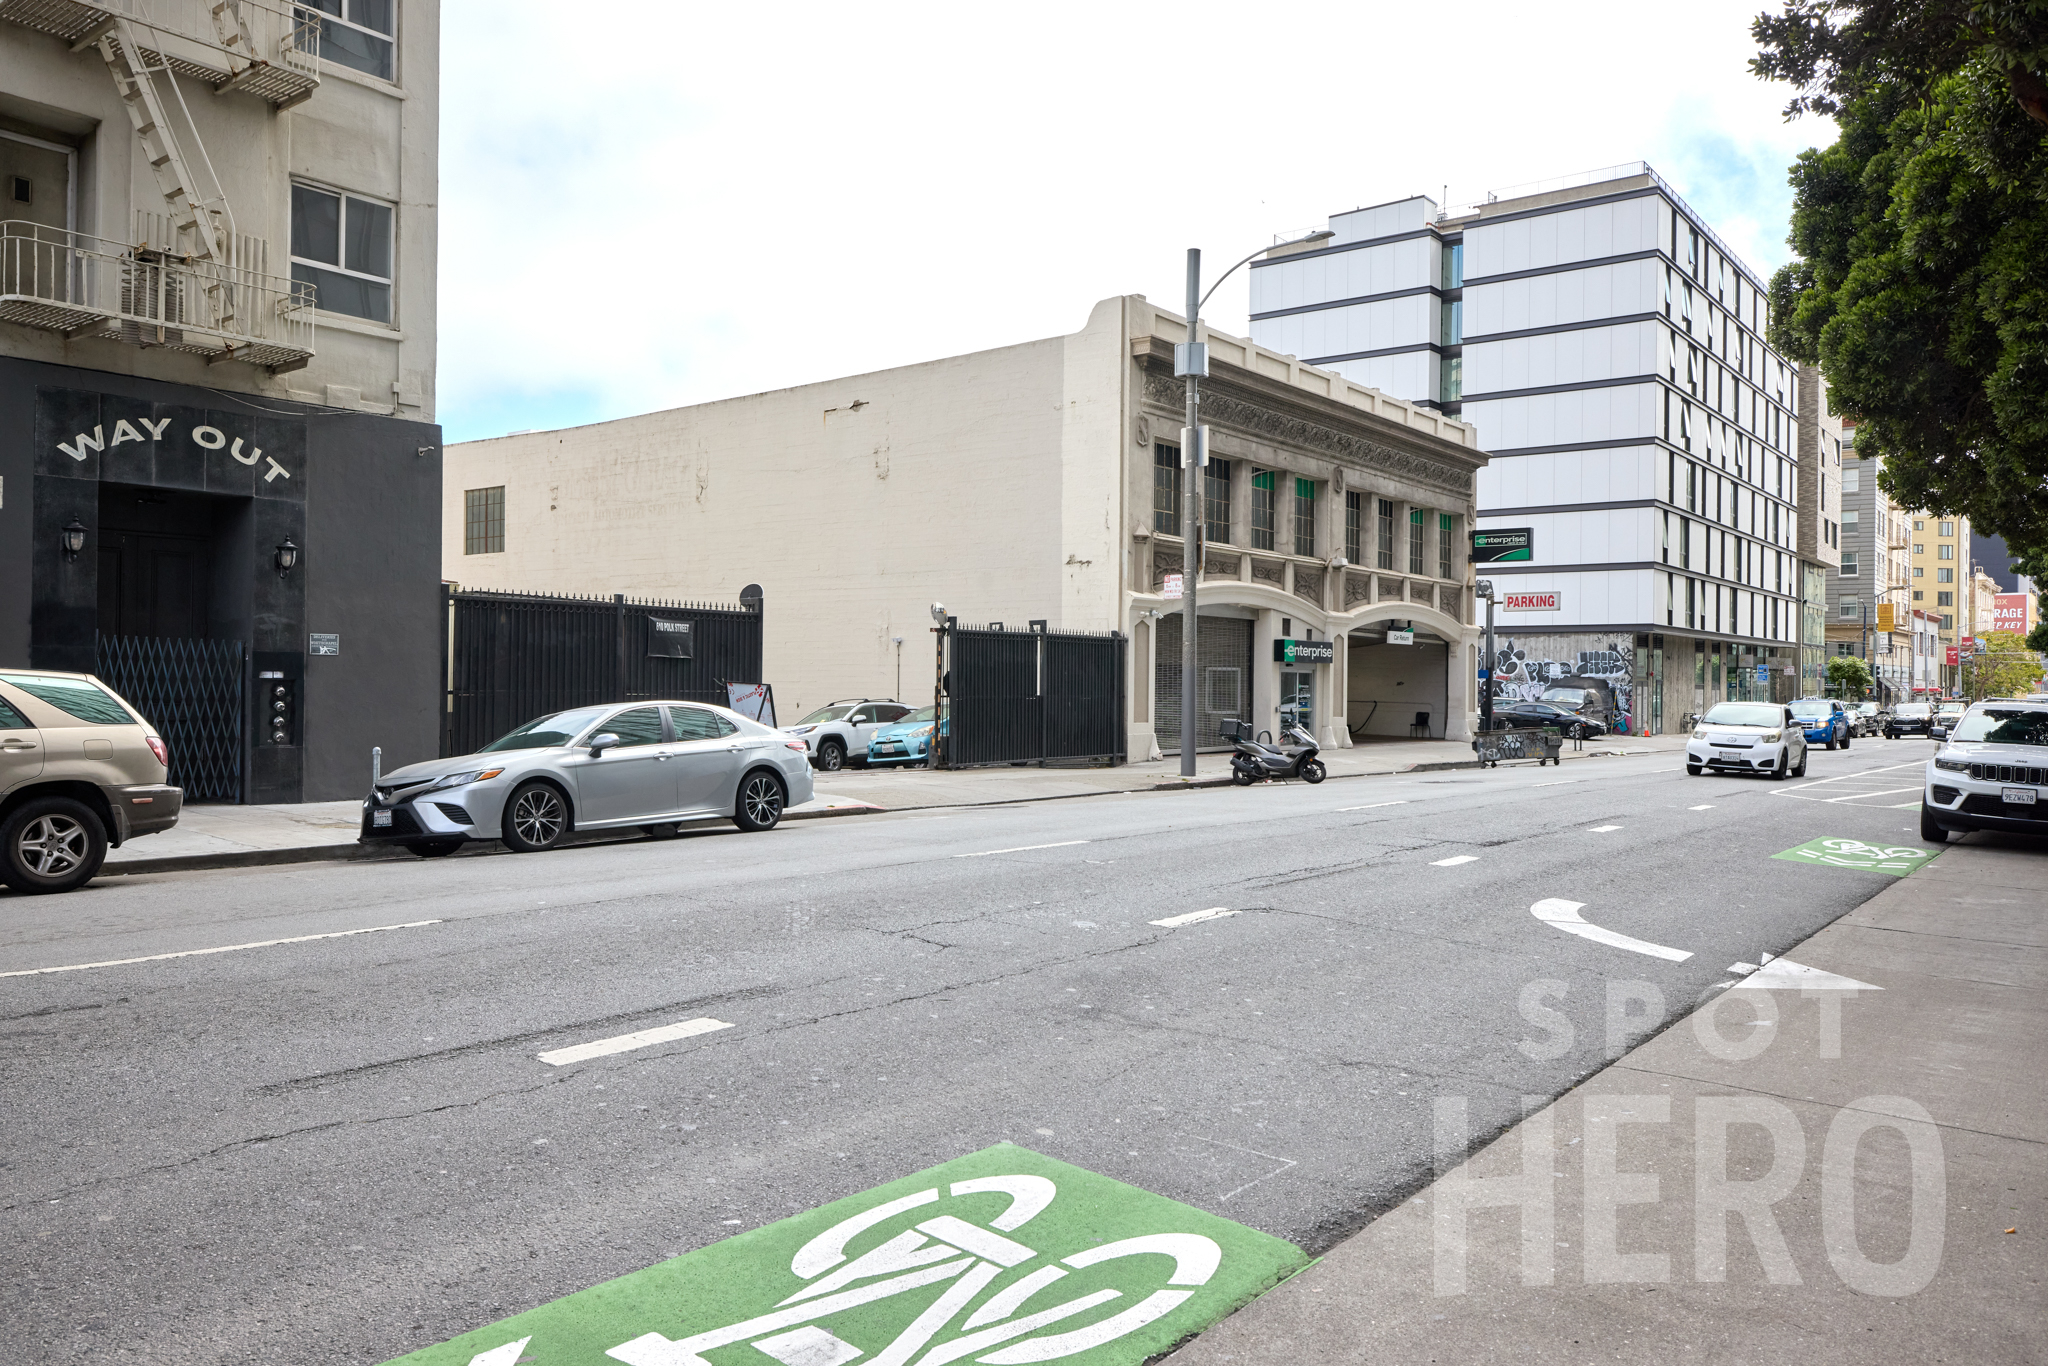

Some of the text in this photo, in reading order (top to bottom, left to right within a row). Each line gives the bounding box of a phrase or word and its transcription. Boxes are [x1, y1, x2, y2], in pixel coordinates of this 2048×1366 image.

[56, 417, 291, 483] WAY OUT
[1477, 536, 1526, 545] enterprise
[1506, 594, 1555, 608] PARKING
[664, 622, 675, 632] POLK
[675, 623, 690, 633] STREET
[2004, 621, 2023, 629] KEY
[1285, 644, 1333, 660] enterprise
[2004, 793, 2034, 803] 9EZW478
